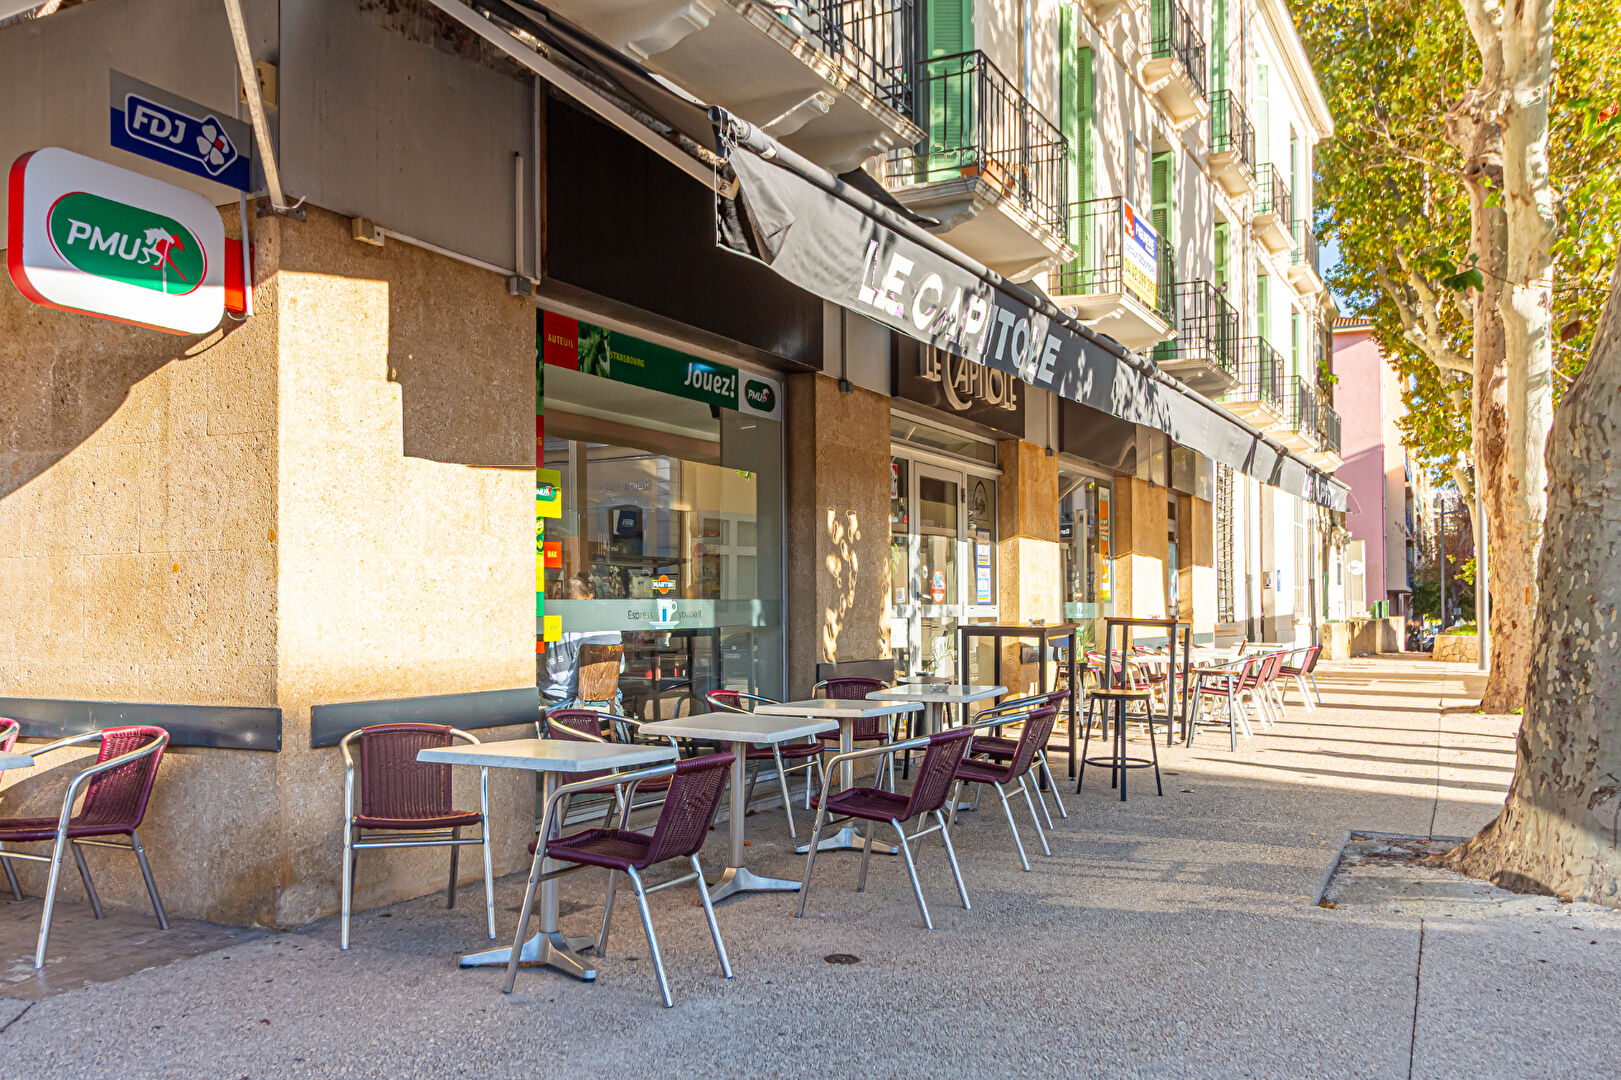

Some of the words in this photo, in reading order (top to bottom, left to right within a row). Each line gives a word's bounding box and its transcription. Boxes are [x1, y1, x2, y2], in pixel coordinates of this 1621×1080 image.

[132, 104, 186, 144] FDJ
[66, 218, 142, 260] PMU
[858, 240, 914, 318] LE
[912, 272, 1062, 385] CAPITOLE
[547, 333, 574, 349] AUTEUIL
[609, 351, 645, 368] STRASBOURG
[684, 362, 736, 399] Jouez!
[921, 344, 942, 382] LE
[940, 350, 1017, 411] CAPITOLE
[747, 389, 764, 403] PMU
[652, 581, 675, 589] MARTINI
[627, 610, 654, 621] Espress
[678, 609, 702, 620] yoself
